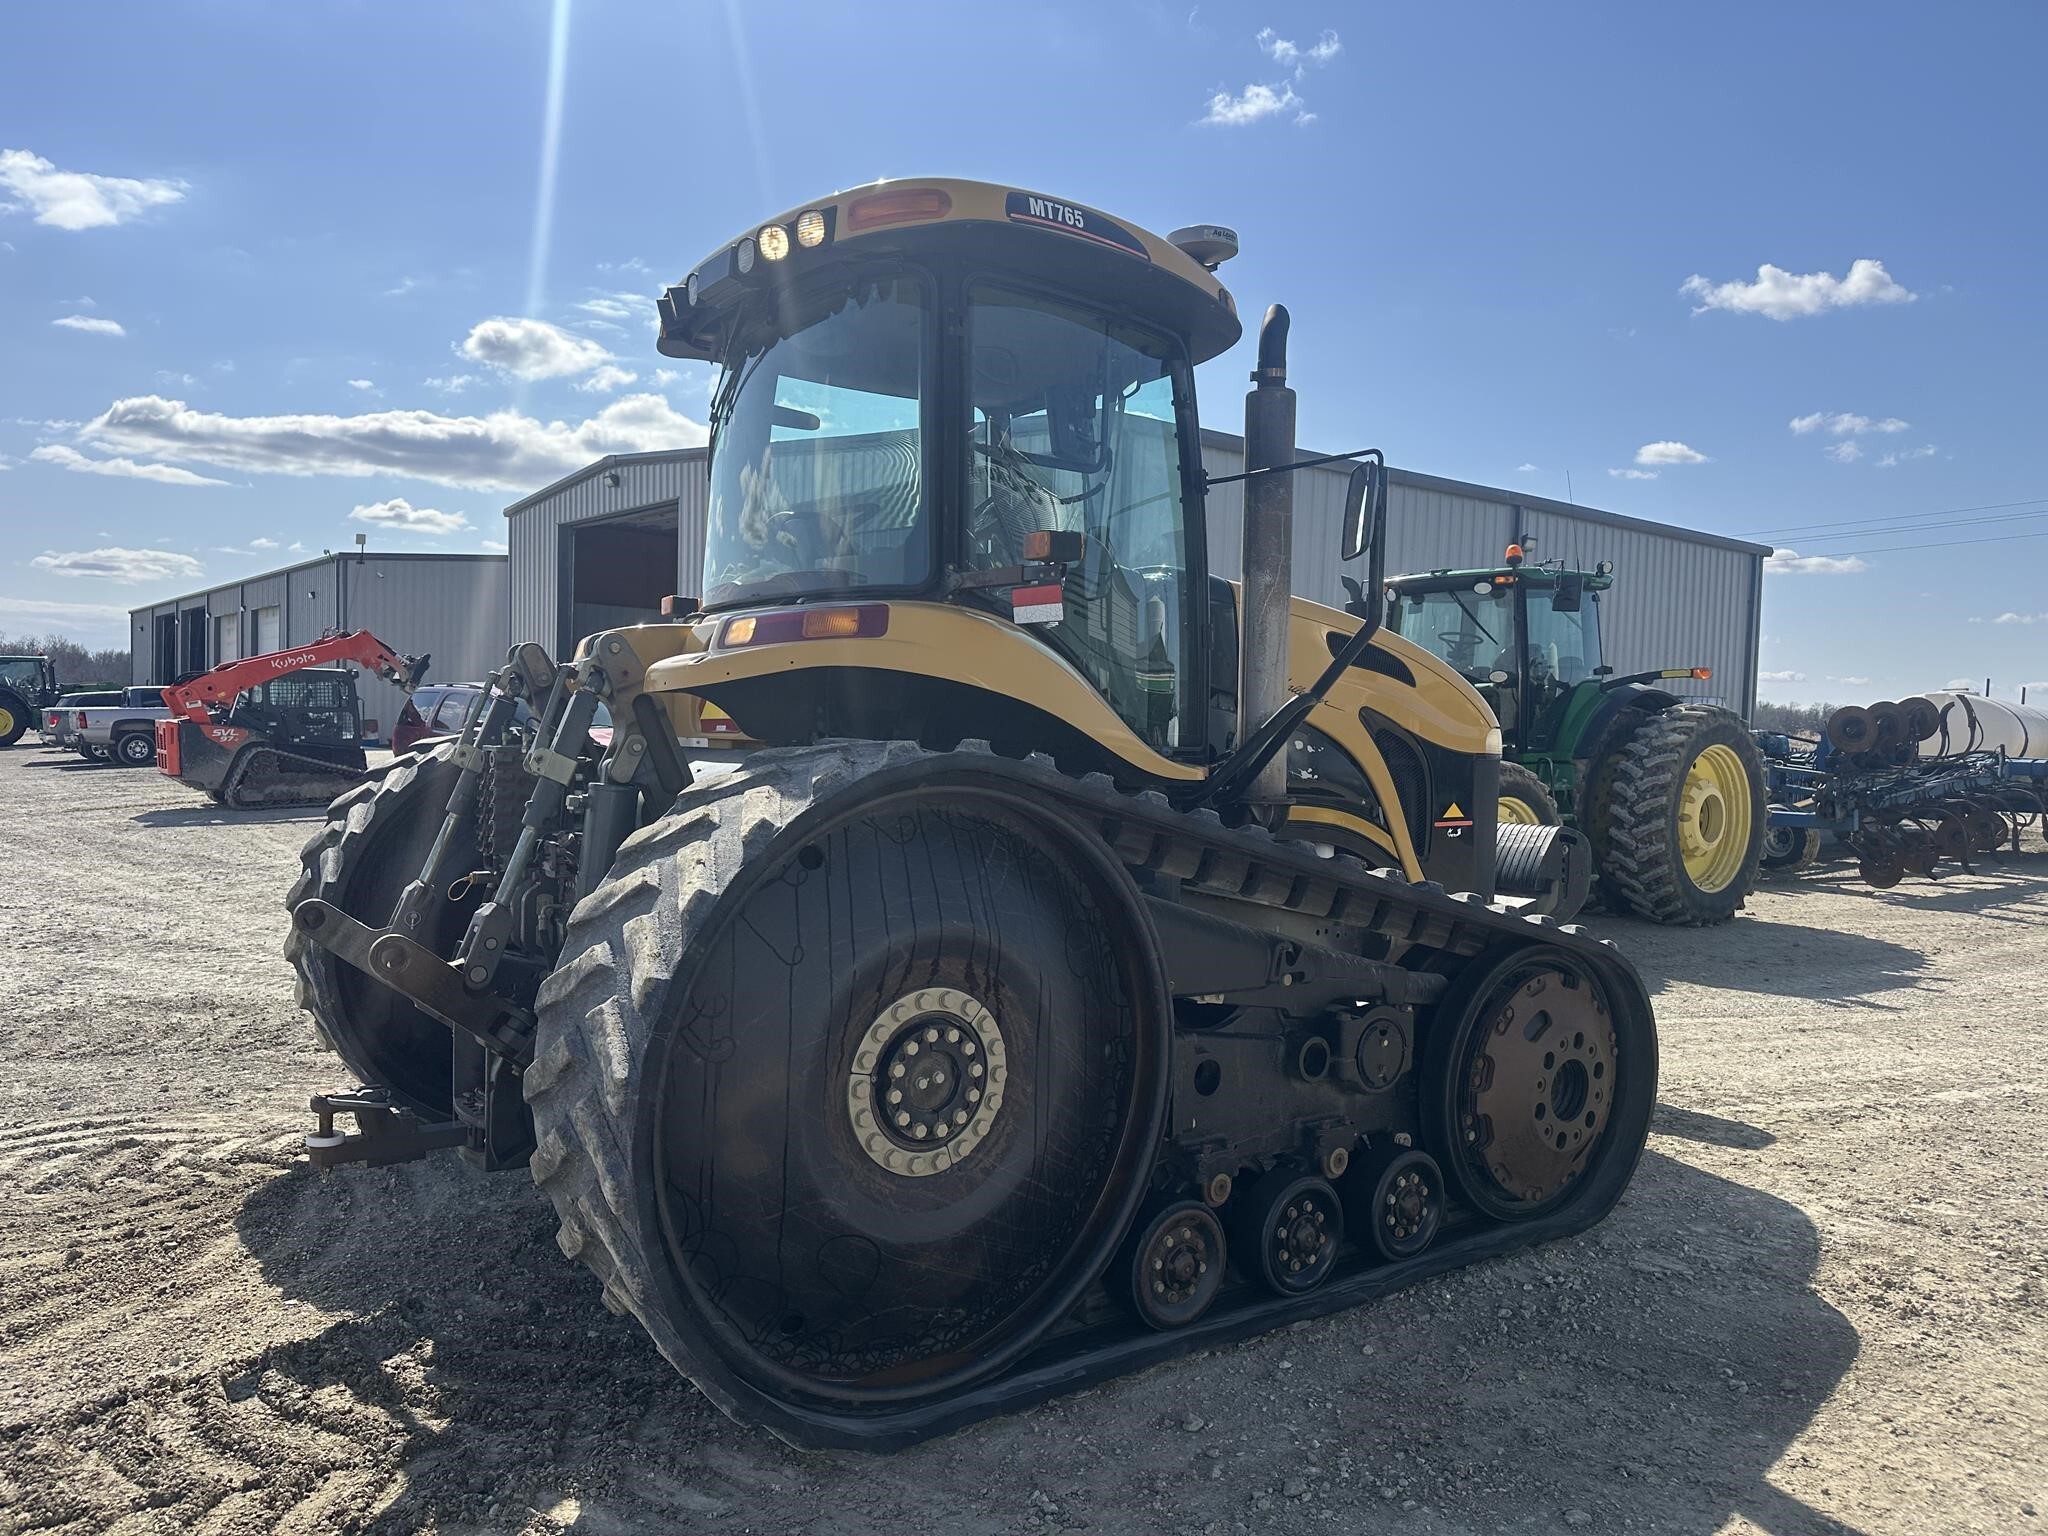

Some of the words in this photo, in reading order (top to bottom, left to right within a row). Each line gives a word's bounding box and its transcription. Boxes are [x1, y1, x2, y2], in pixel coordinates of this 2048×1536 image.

[1028, 196, 1084, 228] MT765
[270, 653, 316, 669] Kubota
[211, 728, 240, 737] SVL
